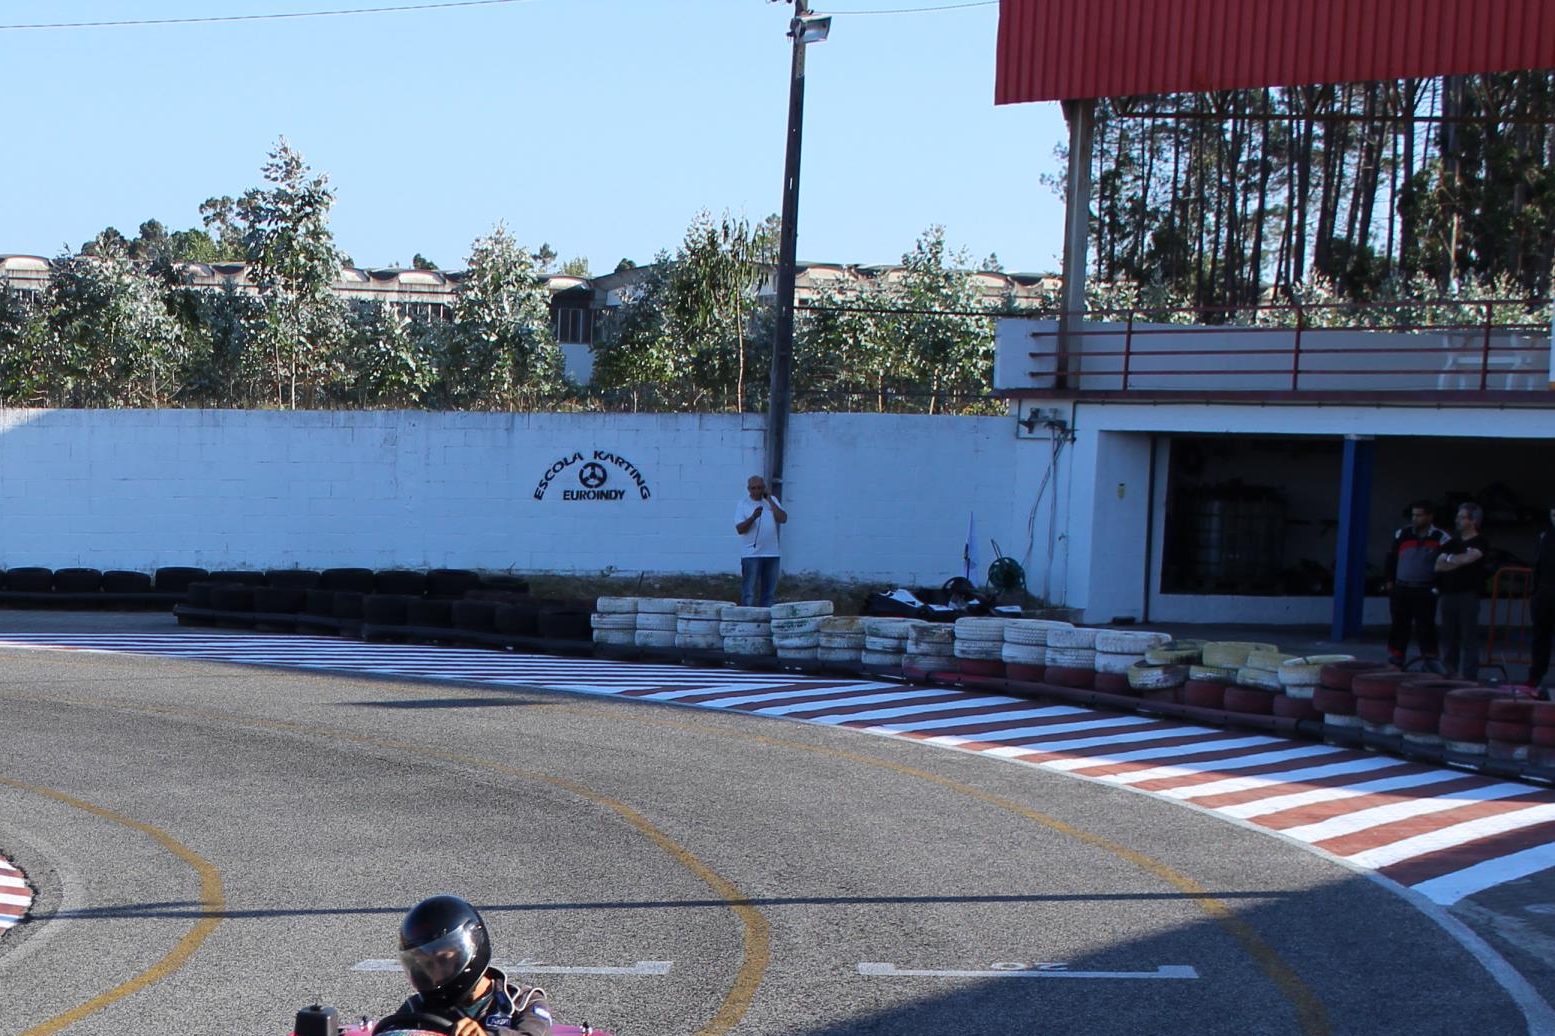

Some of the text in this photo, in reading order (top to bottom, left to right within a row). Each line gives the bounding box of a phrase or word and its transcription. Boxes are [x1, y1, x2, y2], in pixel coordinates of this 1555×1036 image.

[533, 450, 651, 500] ESCOLA KARTING
[563, 489, 626, 501] EUROINDY
